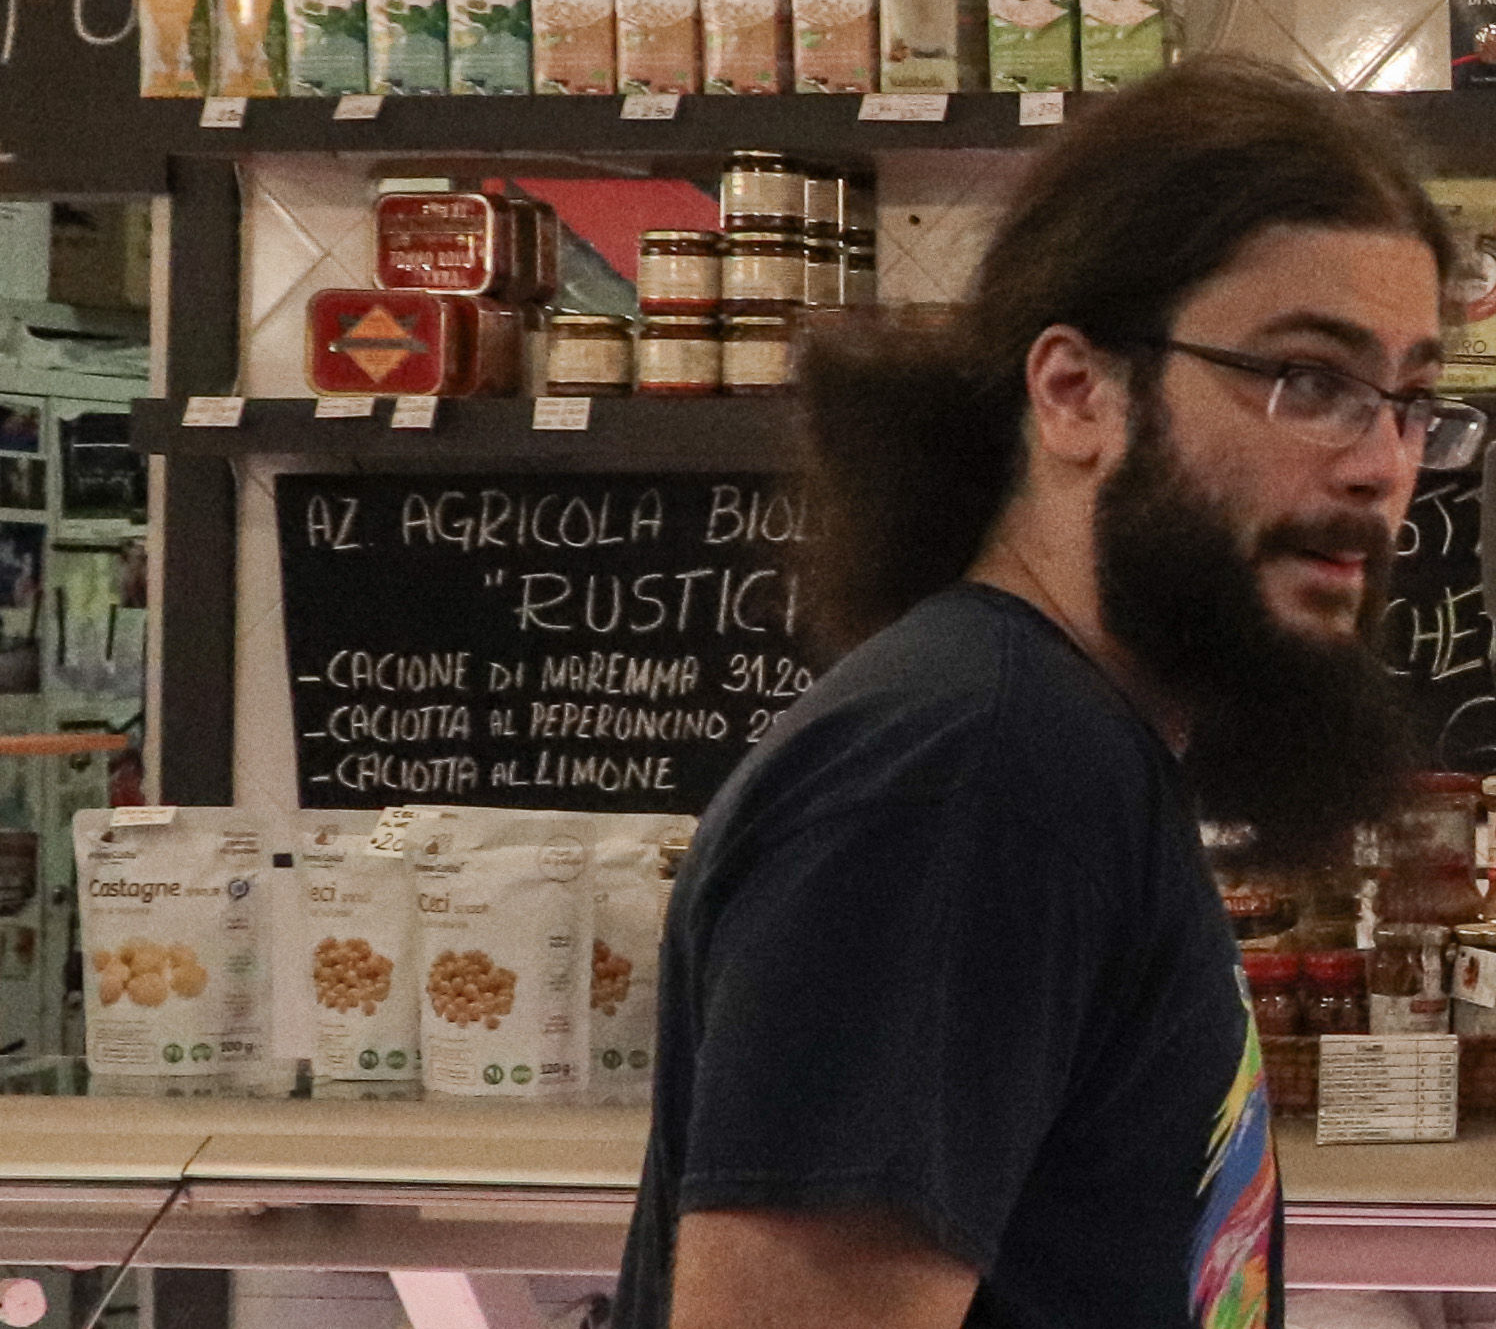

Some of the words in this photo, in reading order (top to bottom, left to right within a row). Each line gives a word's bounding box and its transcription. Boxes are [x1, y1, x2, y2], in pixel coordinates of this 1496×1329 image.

[307, 494, 376, 550] AZ.
[402, 488, 664, 551] AGRICOLA
[489, 660, 525, 693] DI
[540, 652, 700, 701] MAREMMA
[489, 710, 517, 737] AL
[529, 702, 728, 741] PEPERONCINO
[491, 761, 529, 787] AL
[533, 749, 676, 792] LIMONE
[88, 878, 182, 904] Castagne
